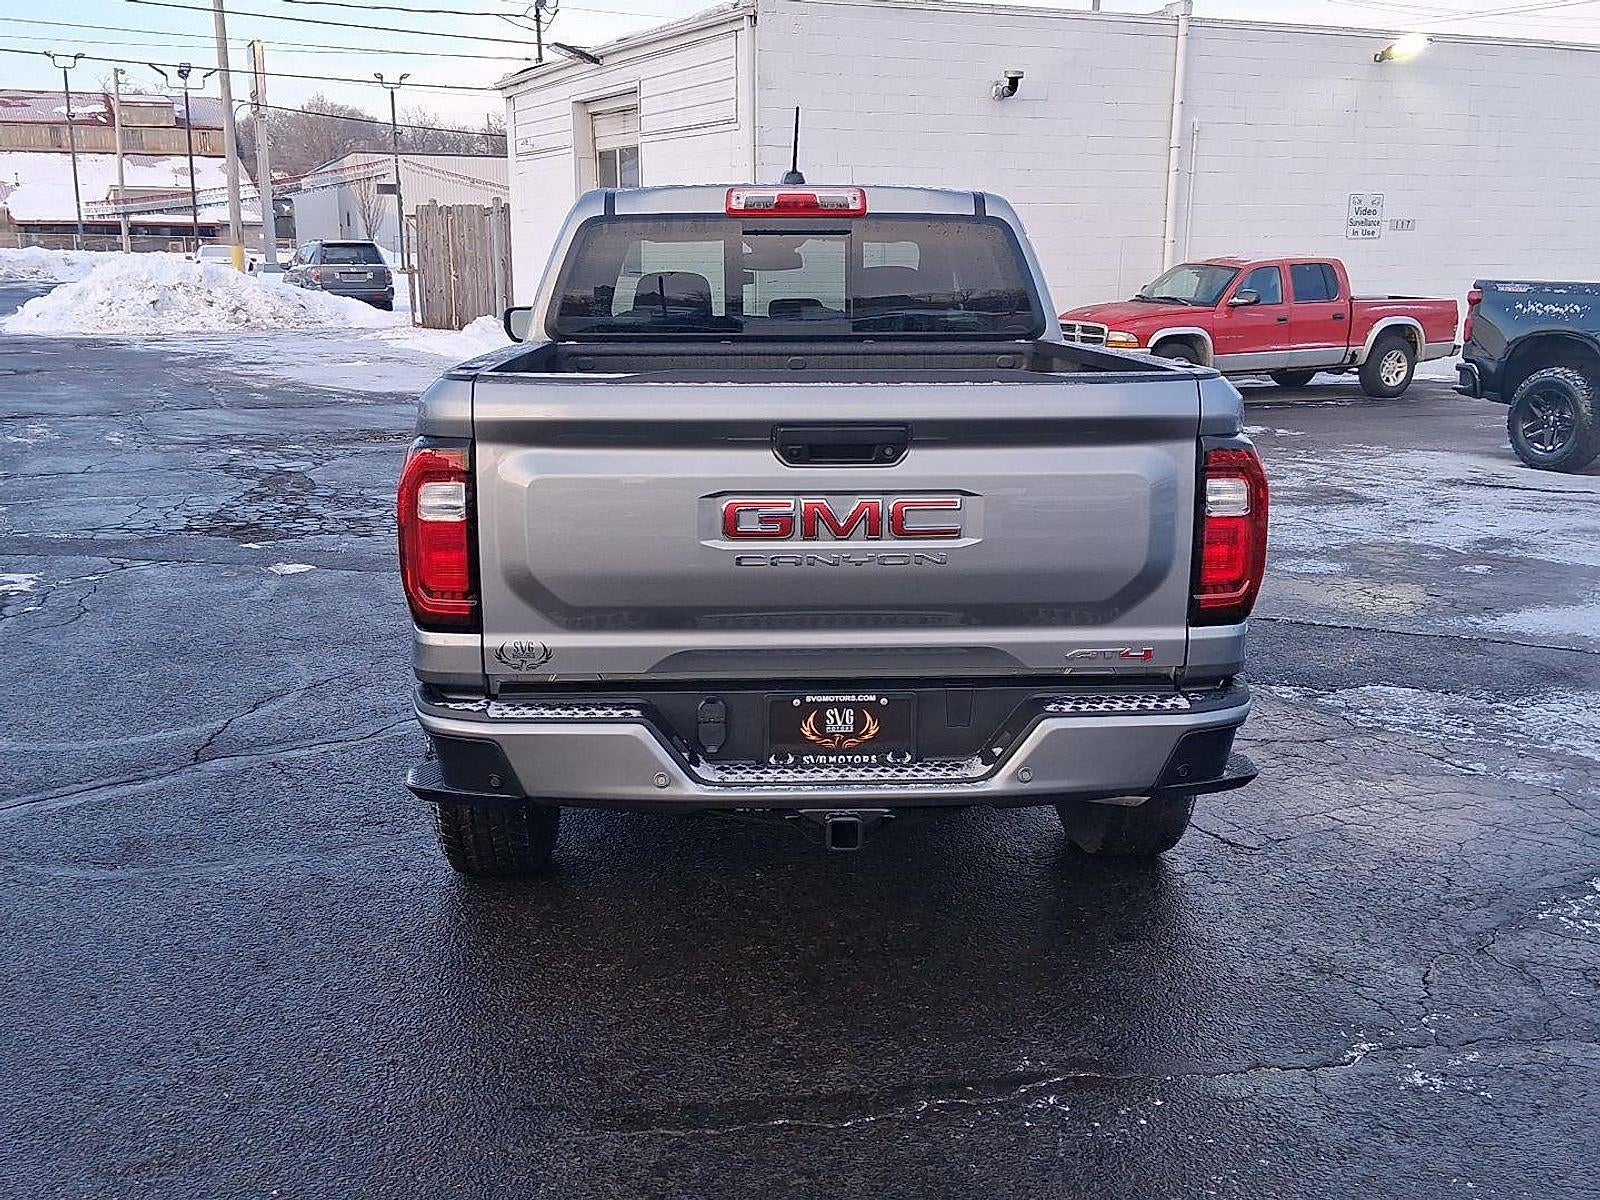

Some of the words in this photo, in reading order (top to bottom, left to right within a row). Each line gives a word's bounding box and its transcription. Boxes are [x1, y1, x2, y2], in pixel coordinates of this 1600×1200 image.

[1354, 206, 1378, 216] Video
[1352, 228, 1359, 236] In
[1361, 228, 1376, 237] Use
[721, 498, 962, 540] GMC
[734, 552, 948, 567] CANYON
[513, 641, 534, 654] SVG
[805, 694, 876, 703] SVGMOTORS.COM
[825, 707, 854, 726] SVG
